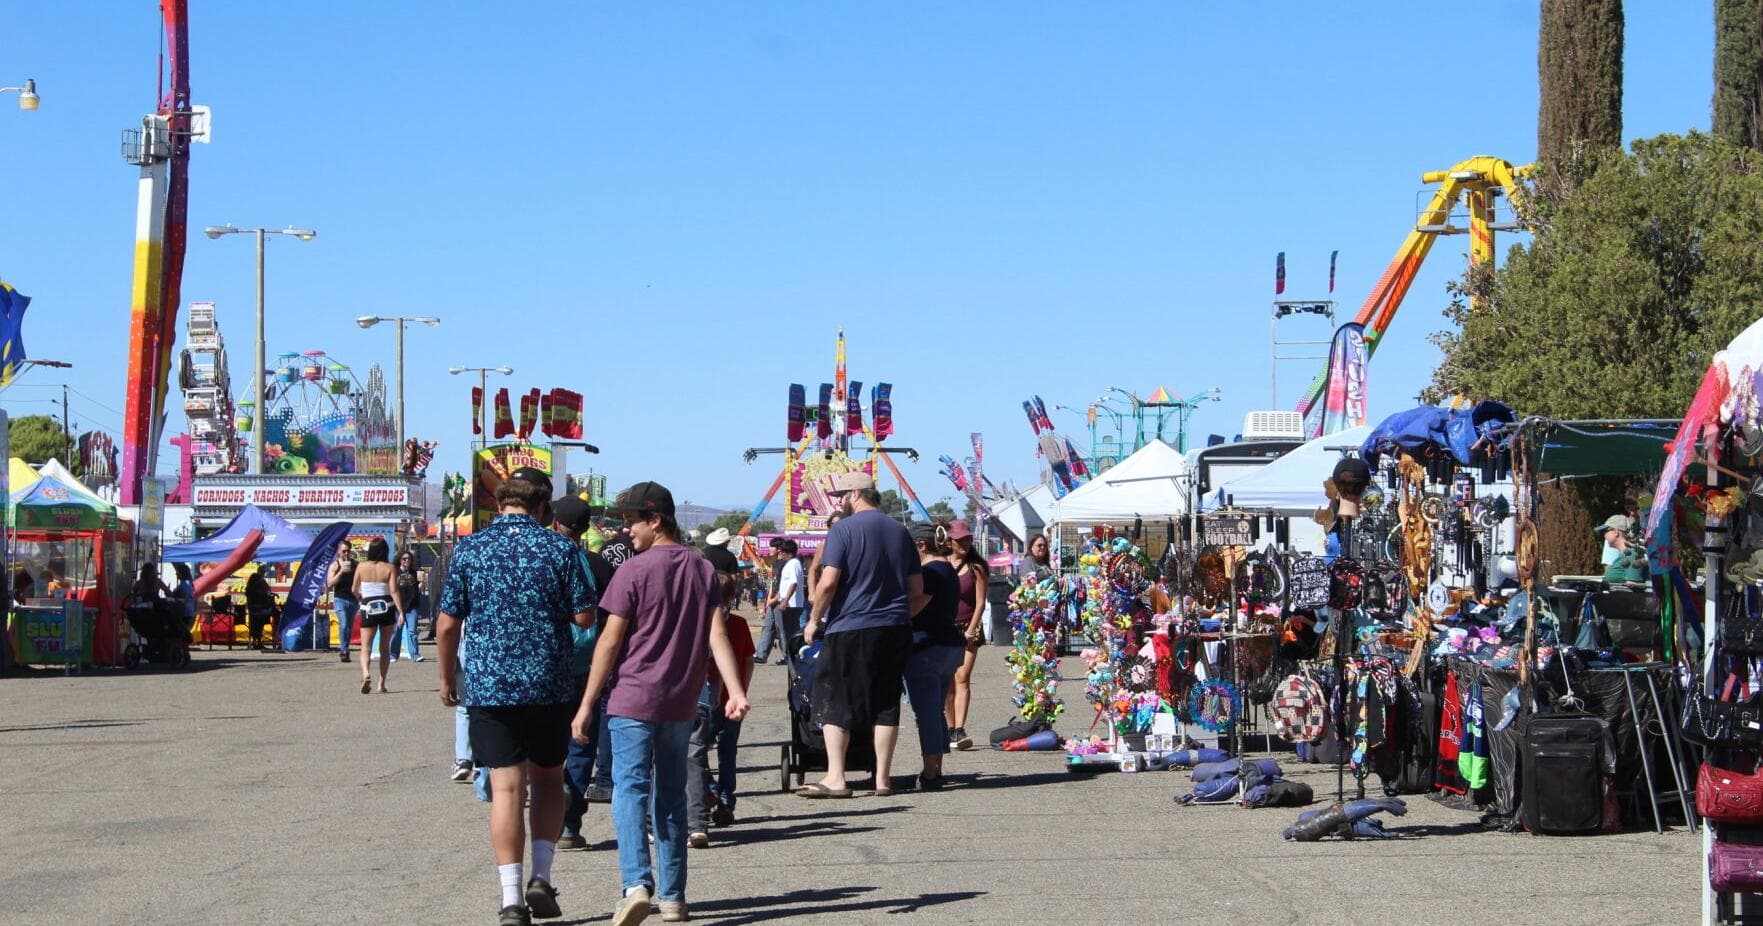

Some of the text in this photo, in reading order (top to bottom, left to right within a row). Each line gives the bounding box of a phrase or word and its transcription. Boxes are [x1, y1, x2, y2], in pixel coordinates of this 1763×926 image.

[511, 456, 547, 470] DOGS
[197, 490, 404, 502] CORNDOGS NACHOS BURRITOS HOTDOGS
[1205, 533, 1253, 545] FOOTBALL
[303, 579, 321, 610] PLAY
